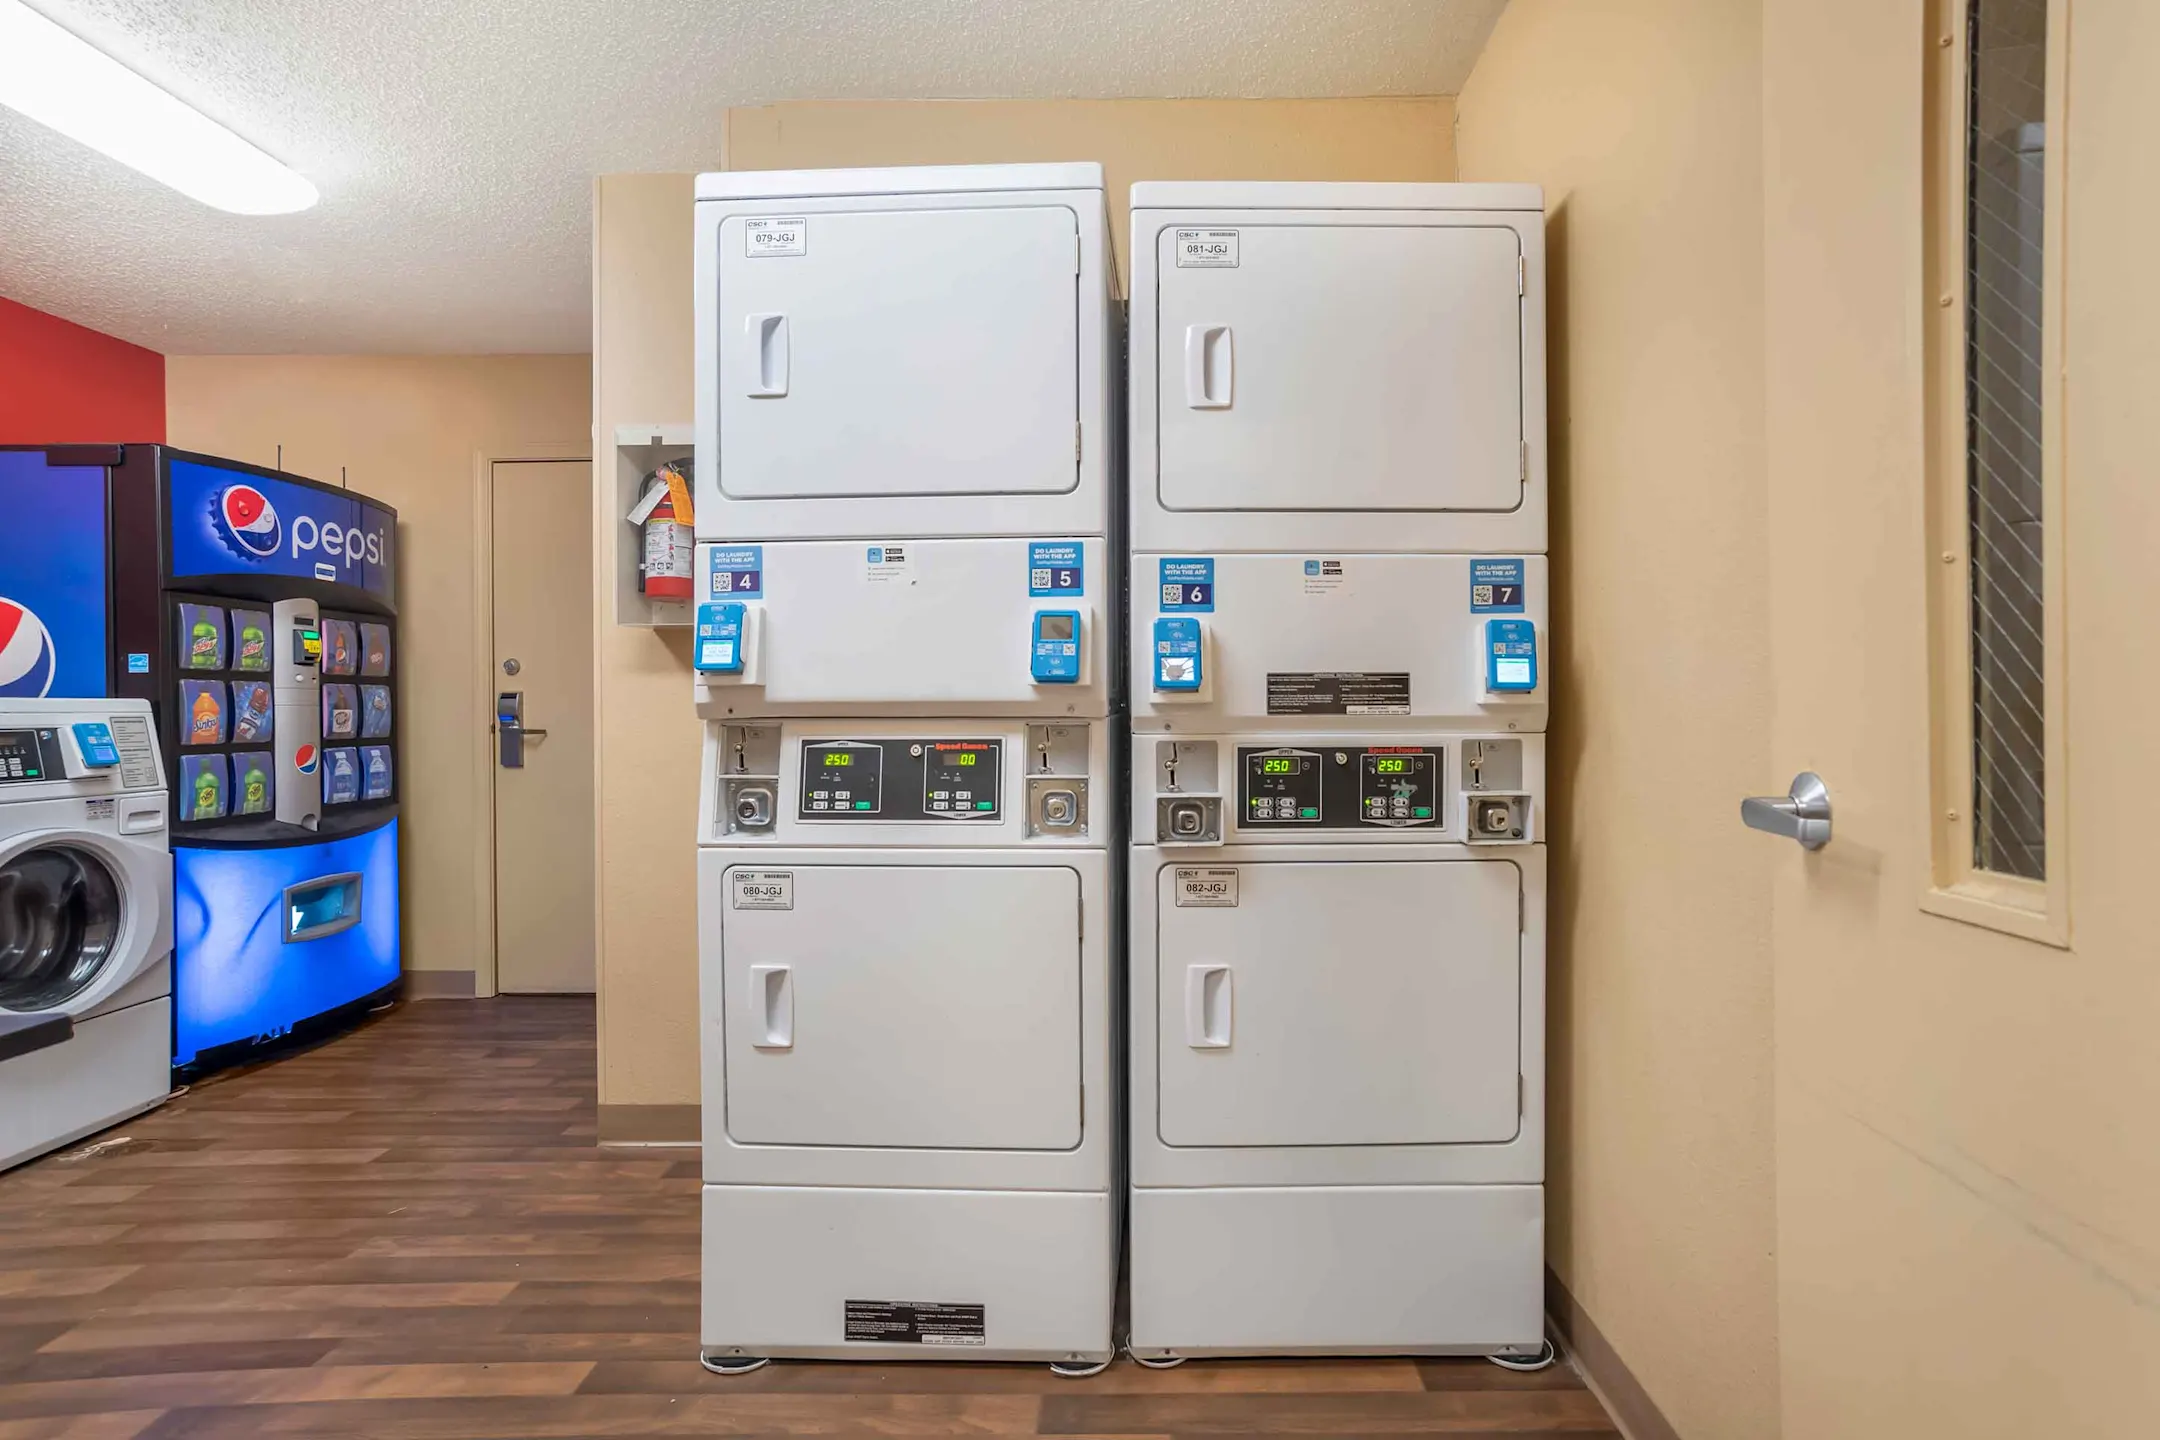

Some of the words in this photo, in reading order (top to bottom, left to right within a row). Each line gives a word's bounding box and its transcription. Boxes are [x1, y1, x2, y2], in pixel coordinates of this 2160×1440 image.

[755, 232, 795, 243] 079-JGJ
[1187, 244, 1228, 253] 081-JGJ
[291, 515, 384, 569] pepsi
[739, 574, 752, 589] 4
[1059, 571, 1071, 586] 5
[1190, 586, 1203, 603] 6
[1500, 587, 1513, 603] 7
[935, 742, 961, 751] Speed
[1368, 745, 1395, 754] Speed
[1395, 745, 1423, 753] Queen
[825, 754, 850, 766] 250
[960, 754, 976, 766] 00
[1265, 760, 1289, 772] 250
[1378, 760, 1402, 772] 250
[743, 886, 782, 895] 080-JGJ
[1186, 883, 1227, 892] 082-JGJ
